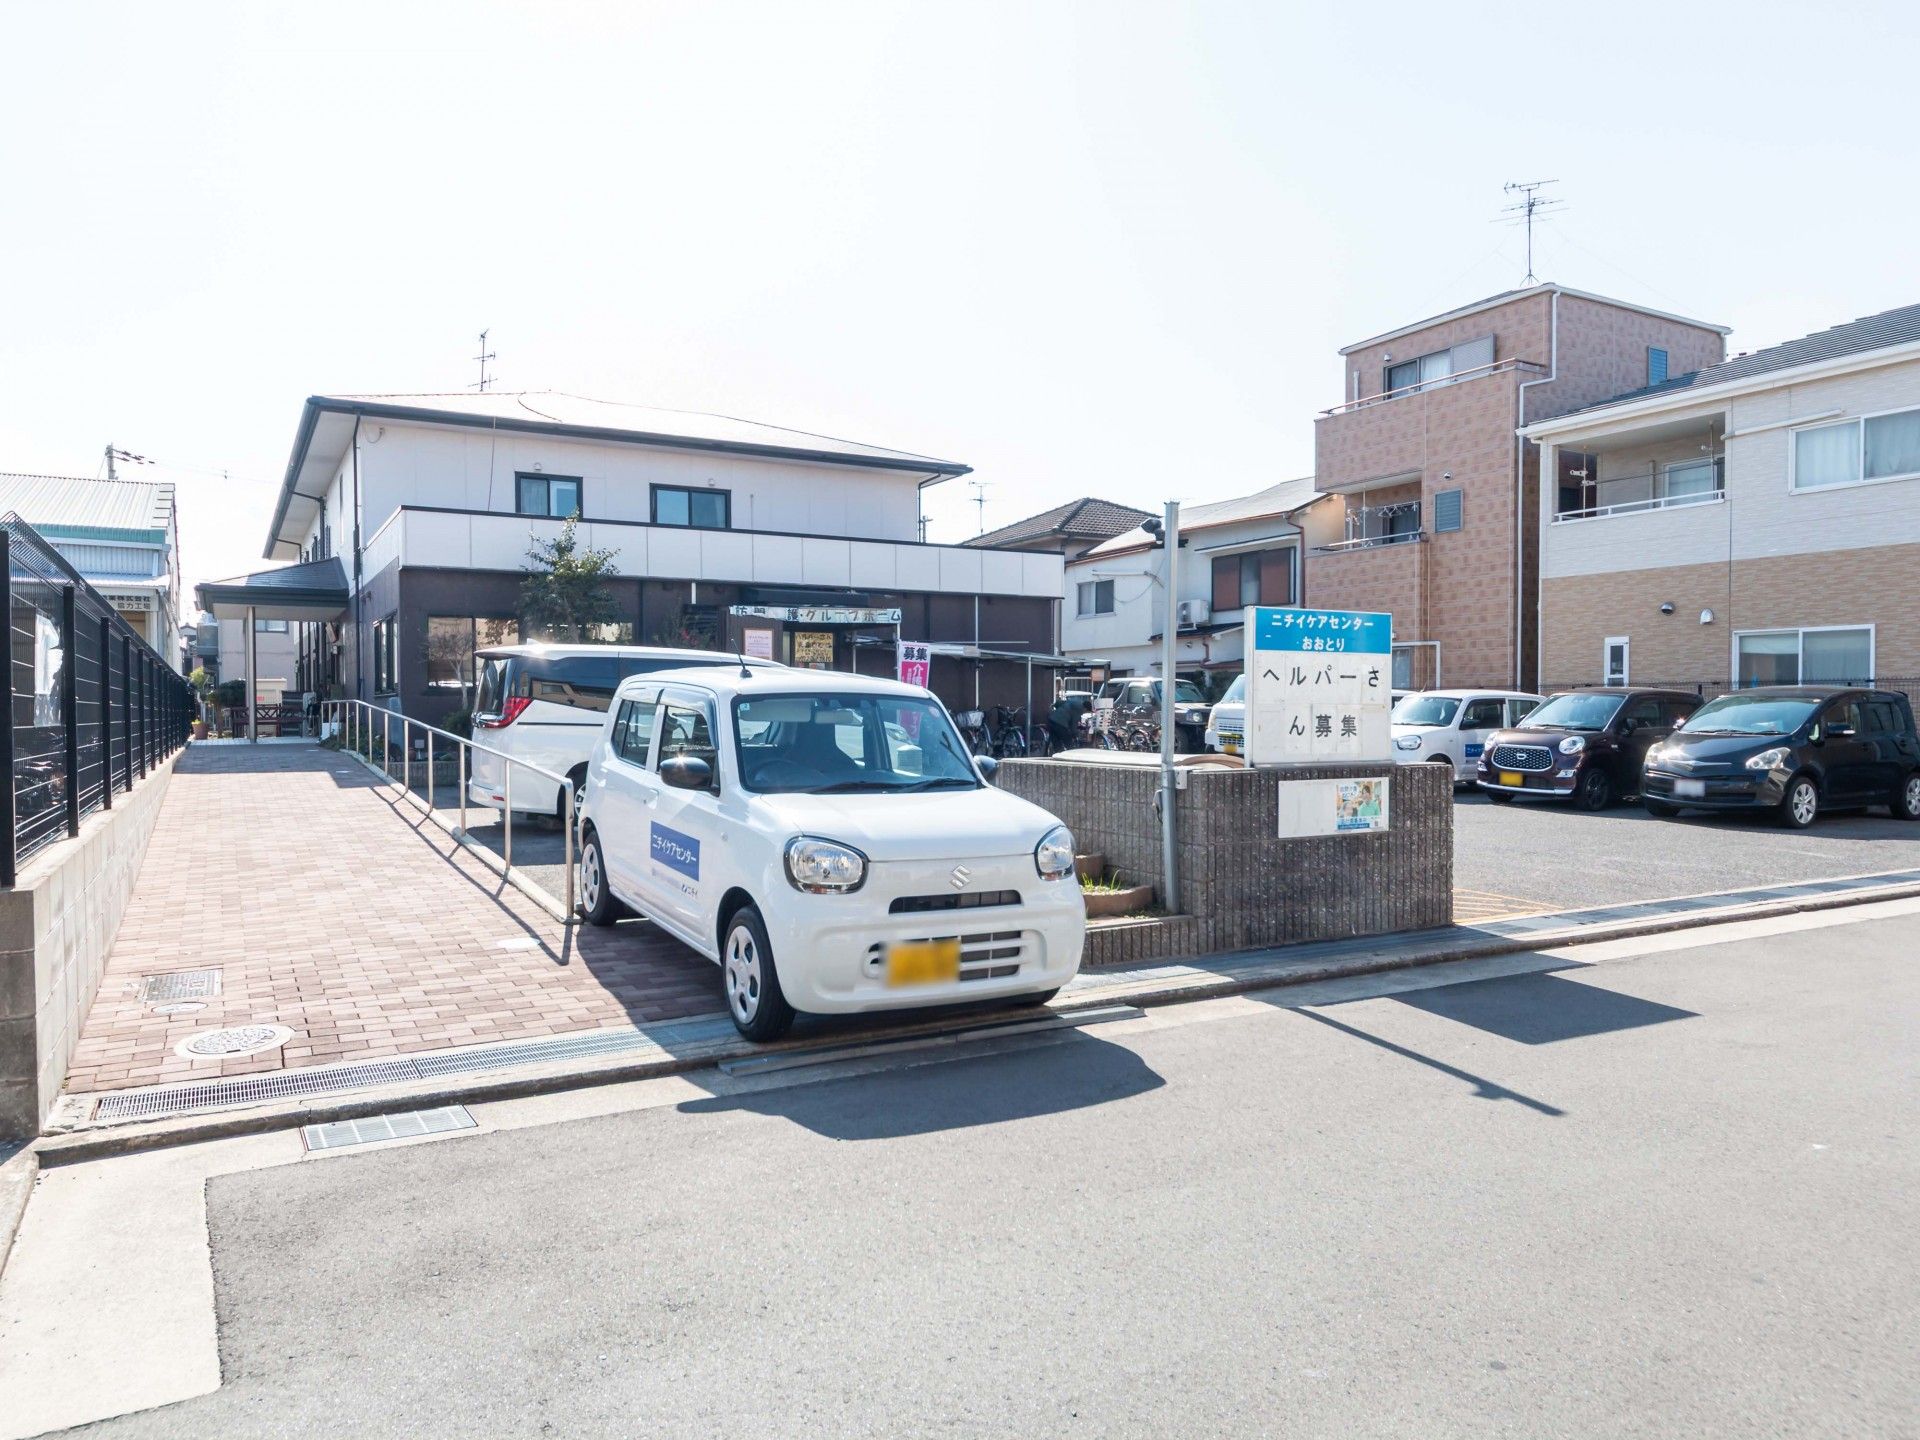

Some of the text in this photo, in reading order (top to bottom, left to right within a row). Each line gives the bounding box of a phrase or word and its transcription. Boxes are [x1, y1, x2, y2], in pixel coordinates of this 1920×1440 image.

[1271, 613, 1374, 630] ニチイケアセンター
[904, 646, 927, 661] 募集
[1302, 636, 1345, 652] おおとり
[1263, 664, 1380, 688] ヘルパーさ
[1289, 714, 1357, 738] ん募集
[652, 834, 697, 864] ニチイケアセンター
